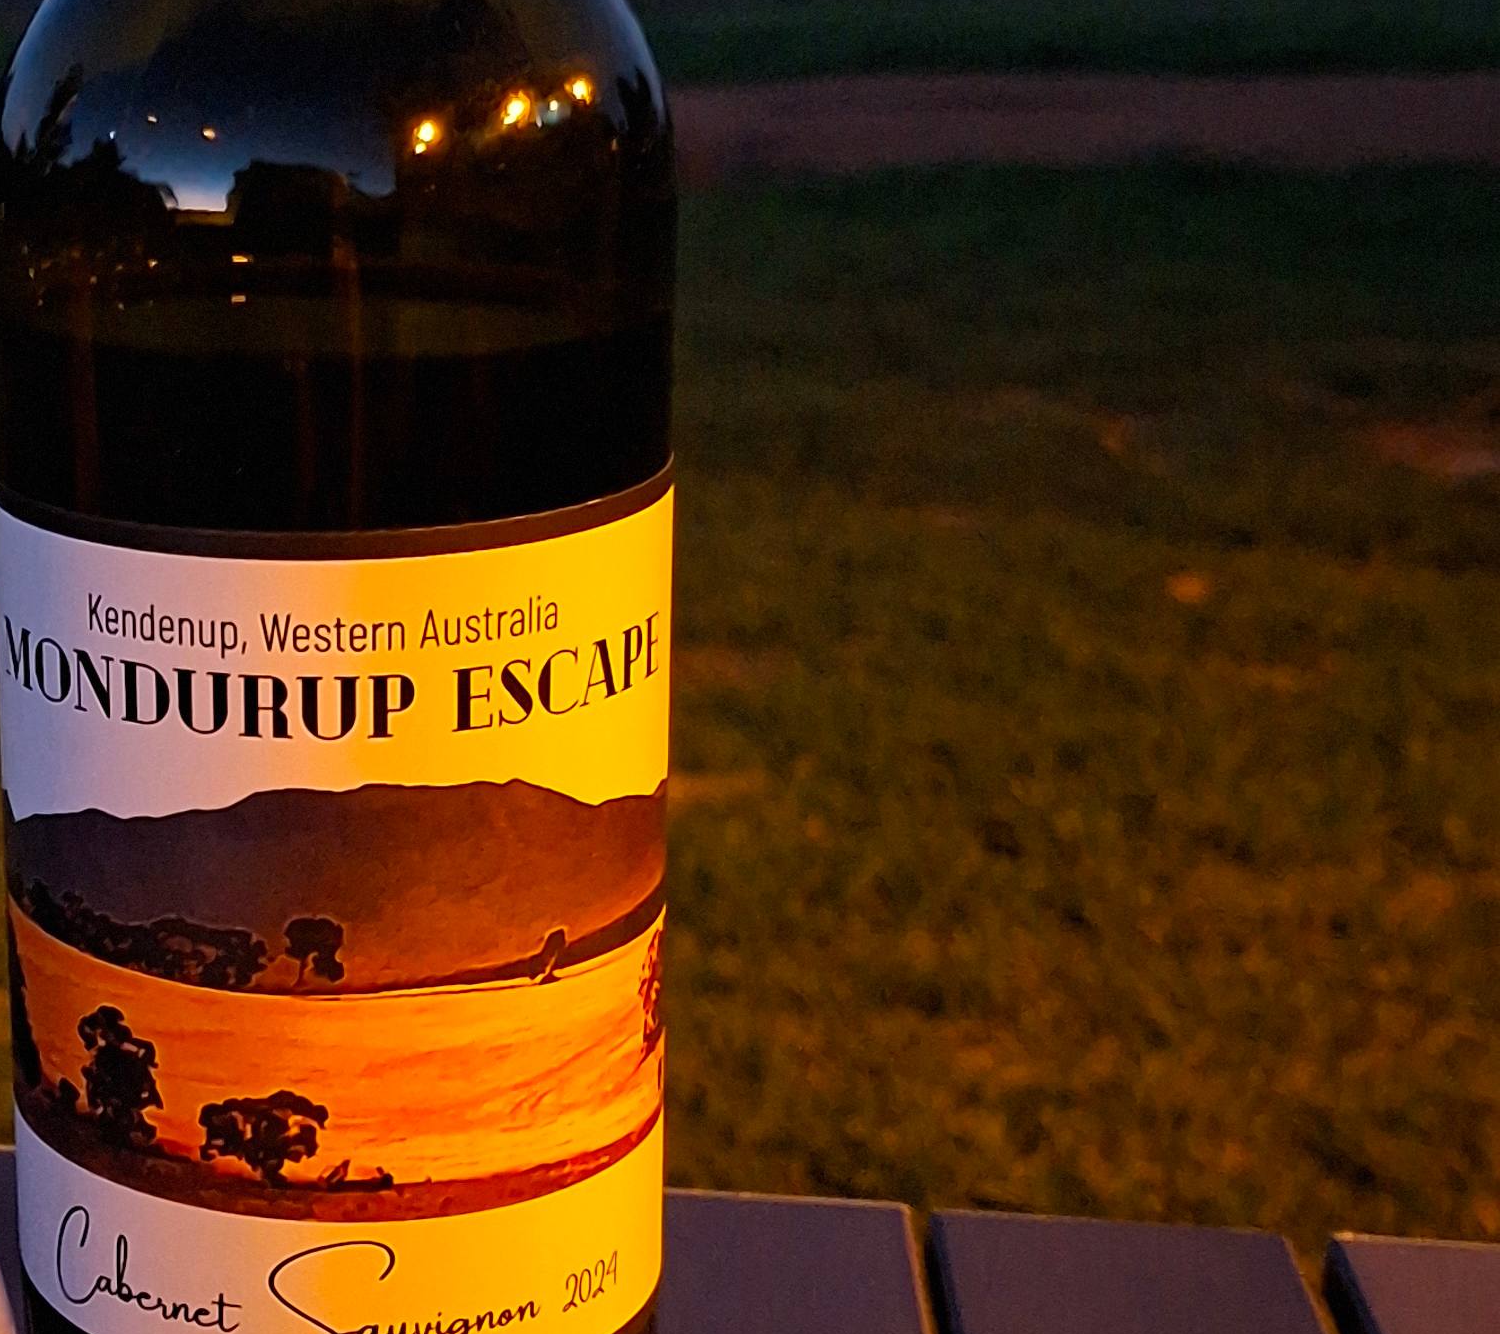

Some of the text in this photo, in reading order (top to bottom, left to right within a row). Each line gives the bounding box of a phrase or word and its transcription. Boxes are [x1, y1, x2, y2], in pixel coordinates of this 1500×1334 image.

[4, 612, 660, 741] MONDURUP ESCAPE
[87, 593, 559, 657] Kendenup, Western Australia
[57, 1205, 242, 1333] Cabernet
[562, 1250, 618, 1313] 2024
